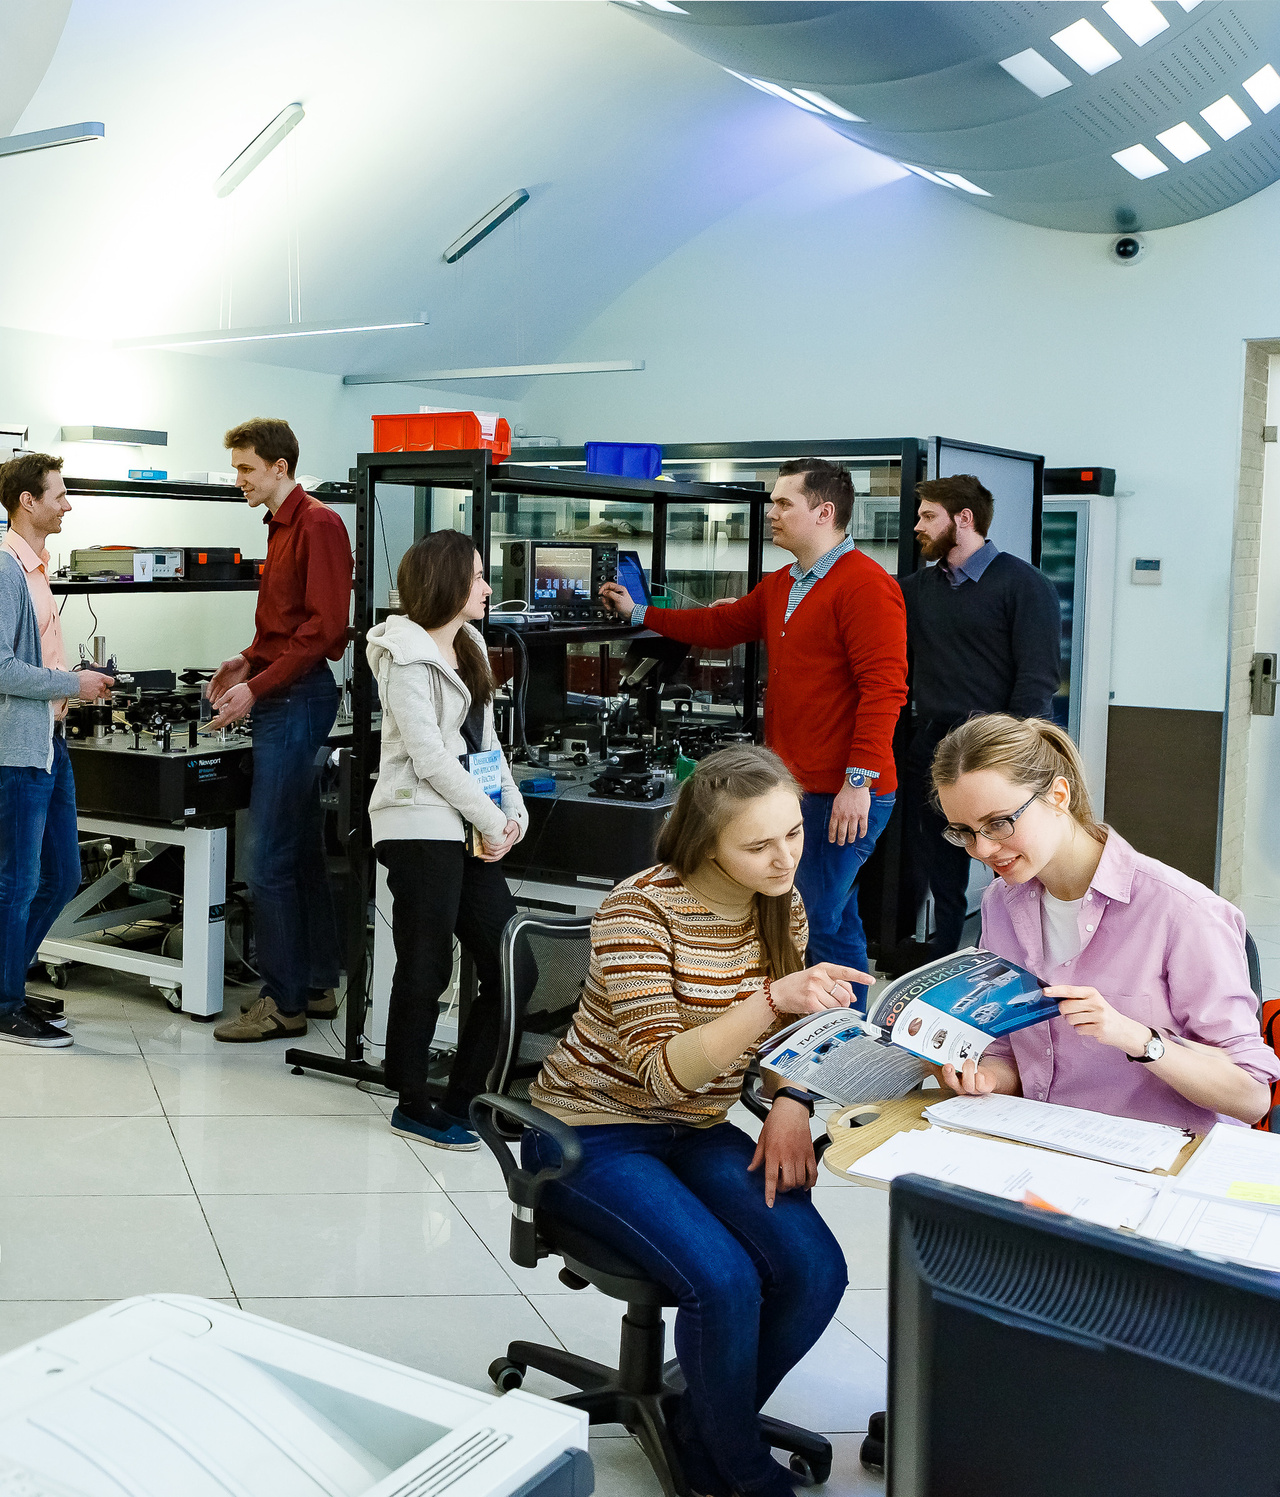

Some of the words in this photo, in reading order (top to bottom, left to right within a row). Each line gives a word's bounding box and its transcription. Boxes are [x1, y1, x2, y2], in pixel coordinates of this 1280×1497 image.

[199, 758, 221, 766] Newport
[886, 963, 973, 1027] ФОТОНИКА
[796, 1017, 851, 1046] ТИДЕКС
